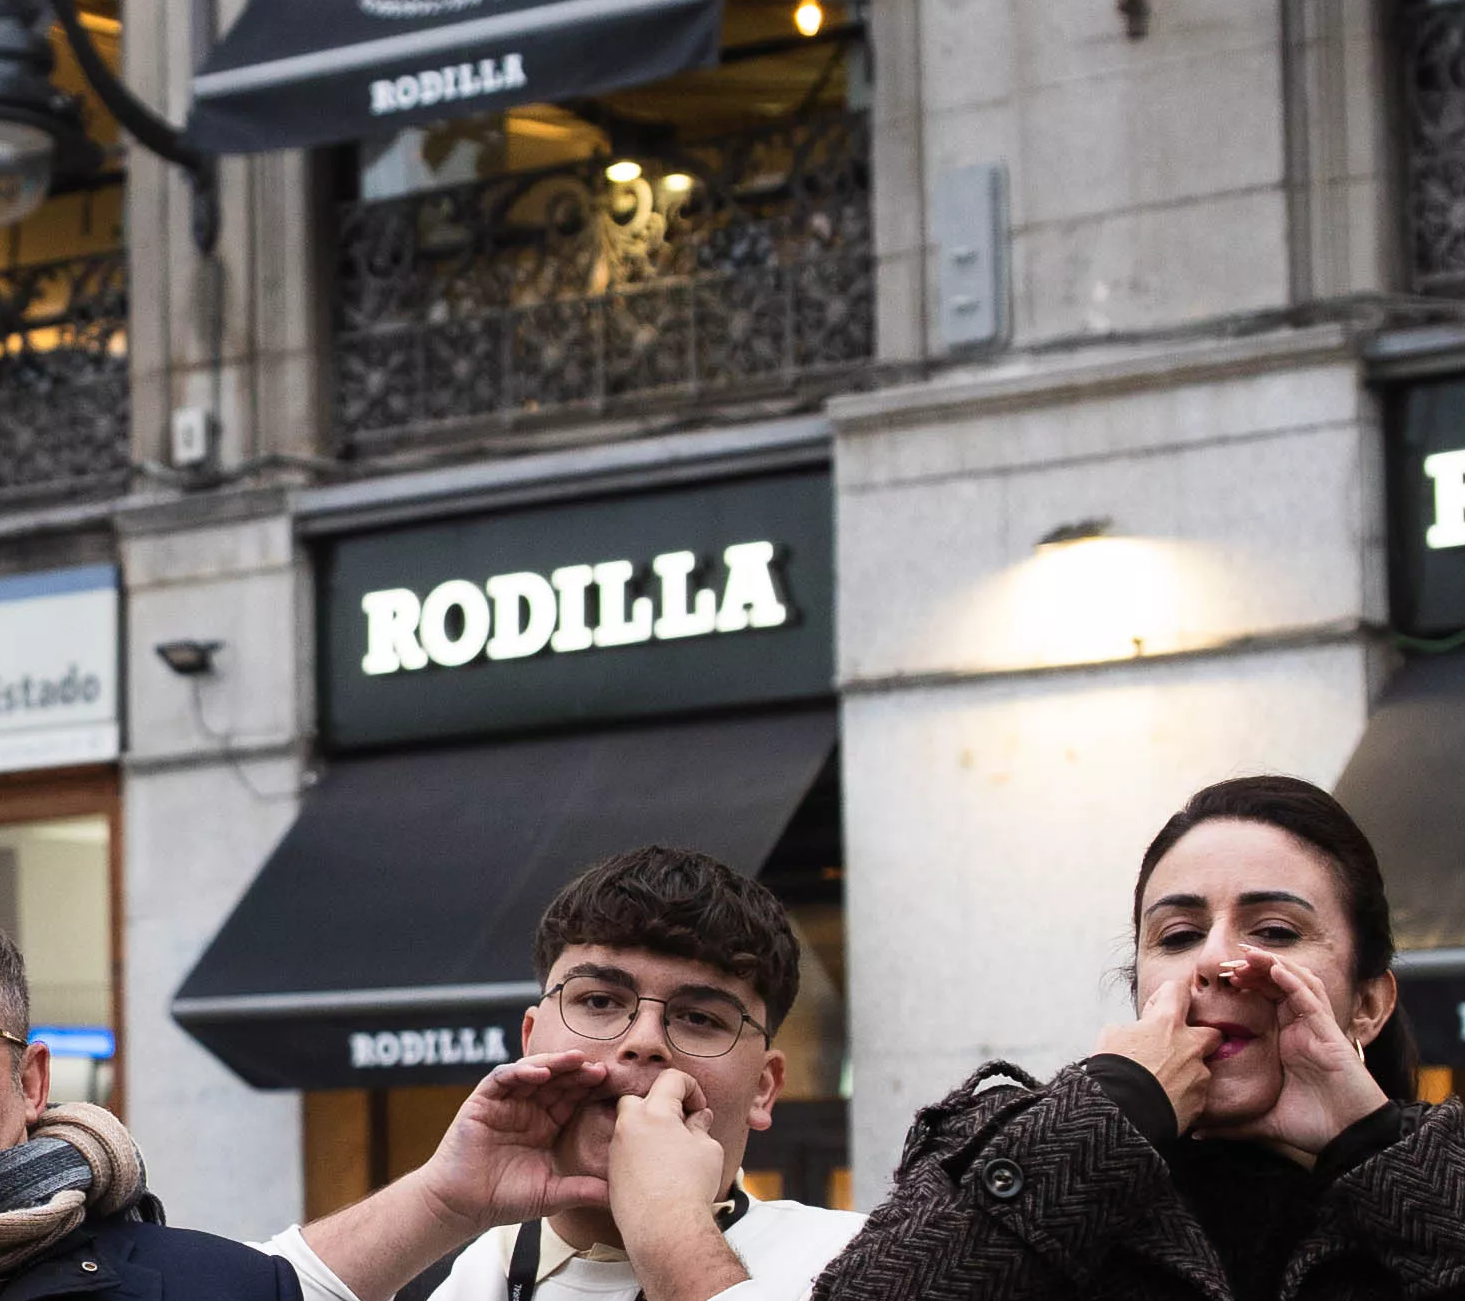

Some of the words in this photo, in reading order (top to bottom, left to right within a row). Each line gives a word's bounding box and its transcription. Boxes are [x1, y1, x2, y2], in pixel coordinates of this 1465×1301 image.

[370, 53, 527, 115] RODILLA
[361, 540, 787, 676] RODILLA
[351, 1027, 508, 1068] RODILLA
